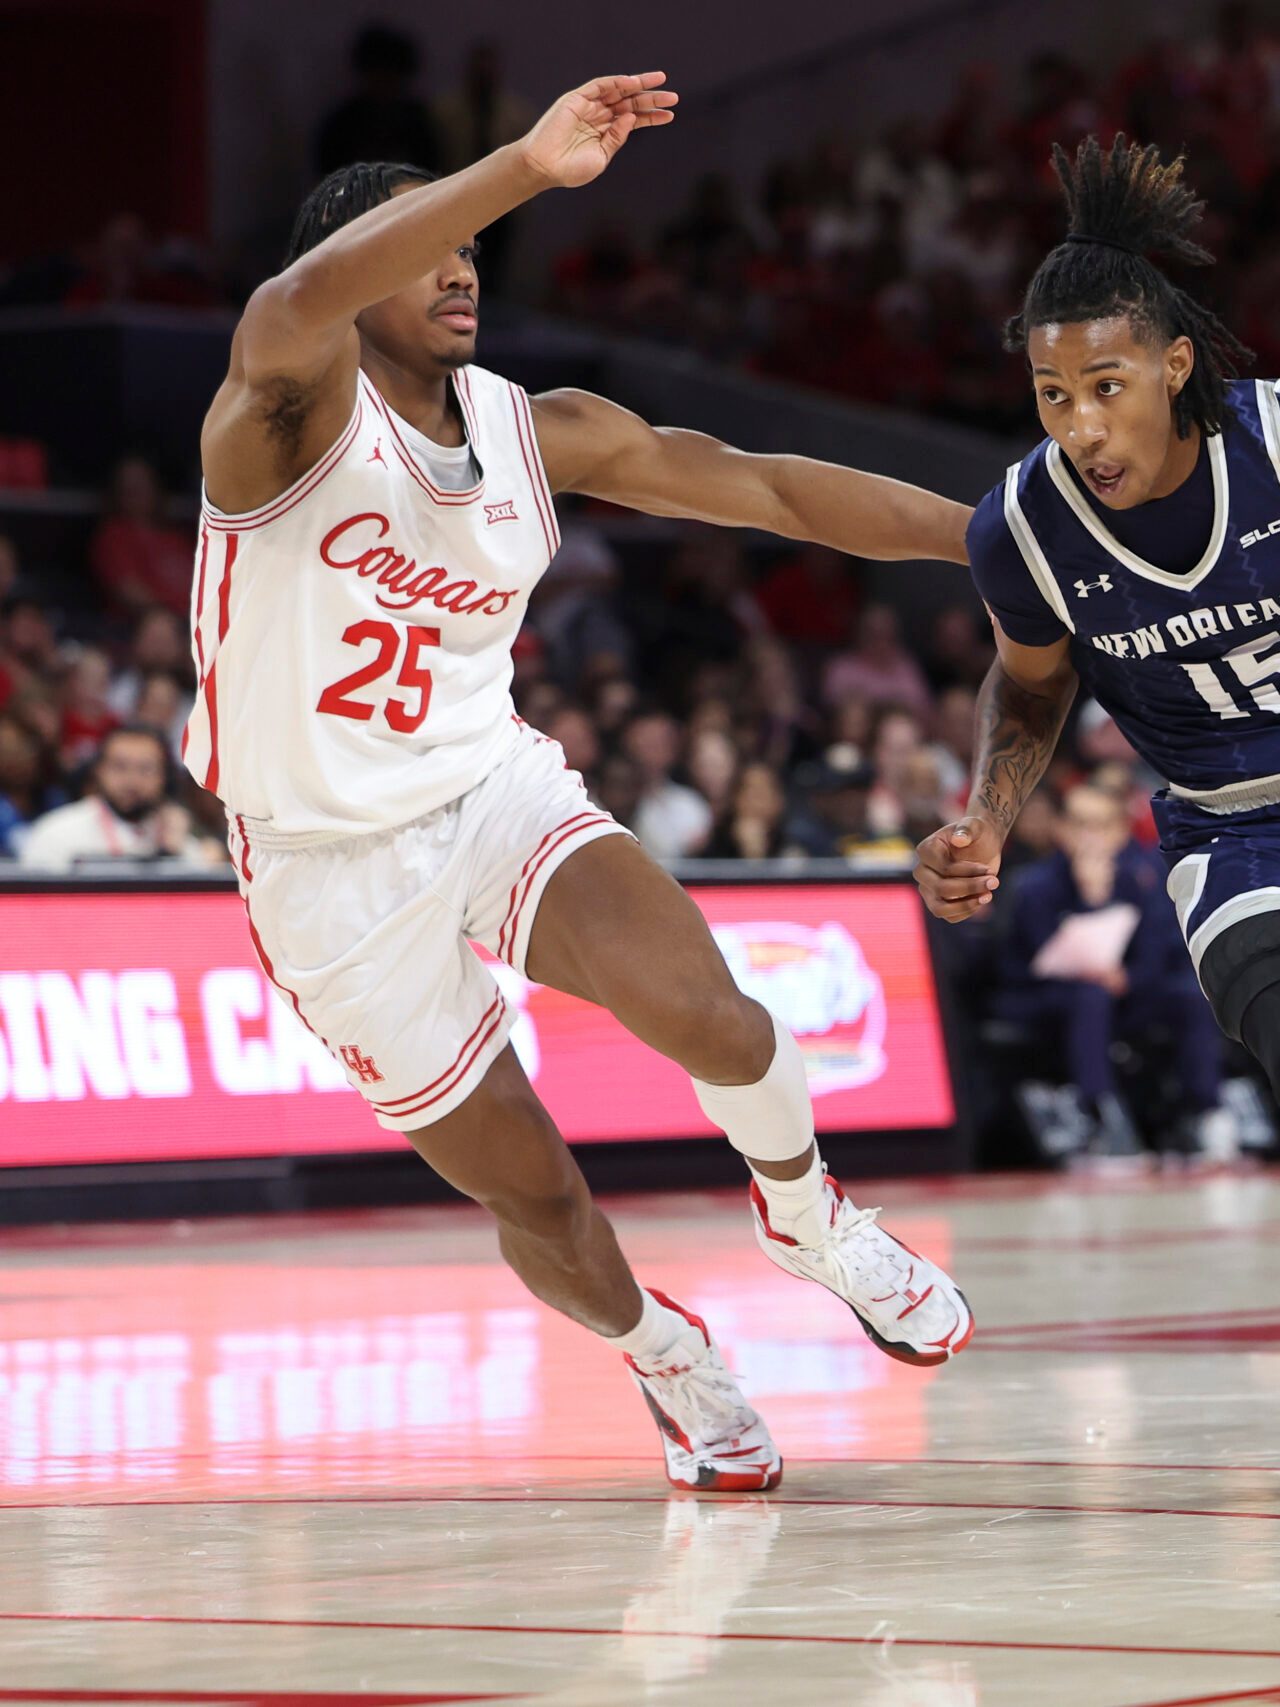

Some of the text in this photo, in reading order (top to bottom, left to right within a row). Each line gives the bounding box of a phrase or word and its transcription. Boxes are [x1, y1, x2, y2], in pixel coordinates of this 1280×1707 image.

[319, 512, 519, 615] Cougars
[316, 619, 440, 733] 25
[1091, 624, 1168, 660] NEW
[0, 968, 193, 1103] ING
